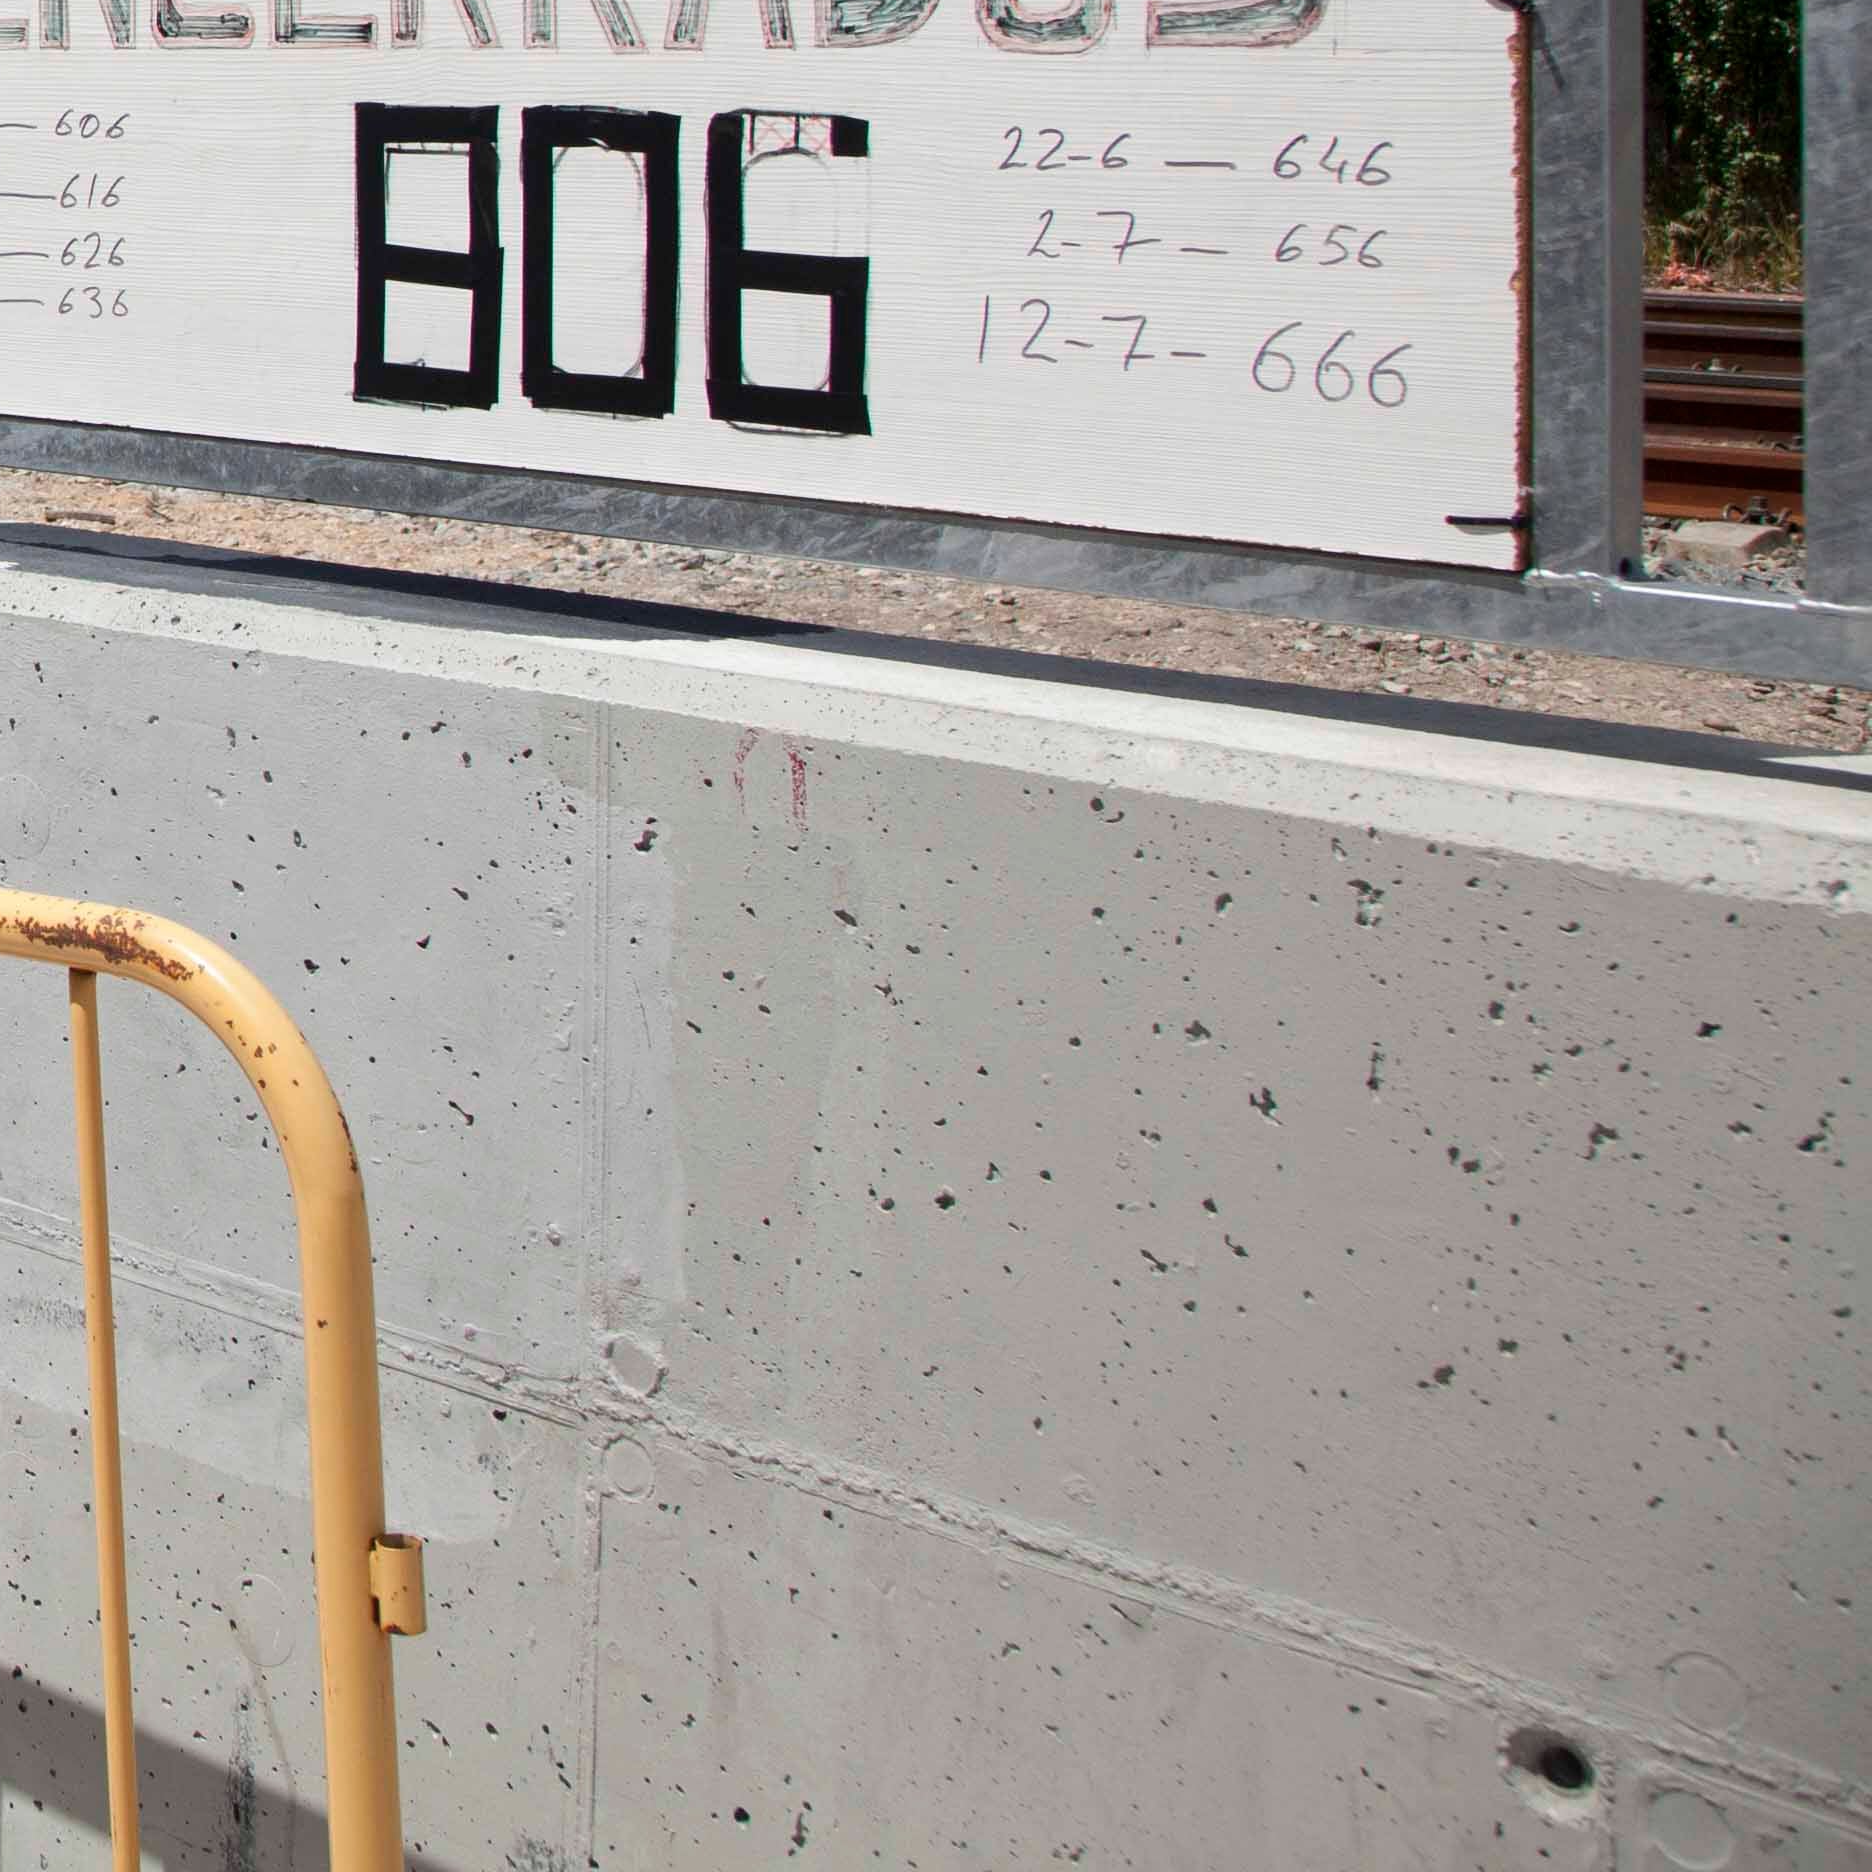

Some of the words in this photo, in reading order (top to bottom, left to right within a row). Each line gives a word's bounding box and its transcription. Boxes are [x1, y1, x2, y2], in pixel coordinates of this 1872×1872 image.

[55, 109, 130, 139] 606
[998, 126, 1131, 171] 22-6
[1273, 134, 1392, 186] 646
[60, 174, 125, 208] 616
[61, 232, 125, 269] 626
[1027, 209, 1162, 264] 2-7
[1275, 224, 1387, 268] 656
[353, 102, 872, 436] 806
[59, 287, 128, 318] 636
[979, 296, 1155, 371] 12-7
[1252, 322, 1412, 407] 666
